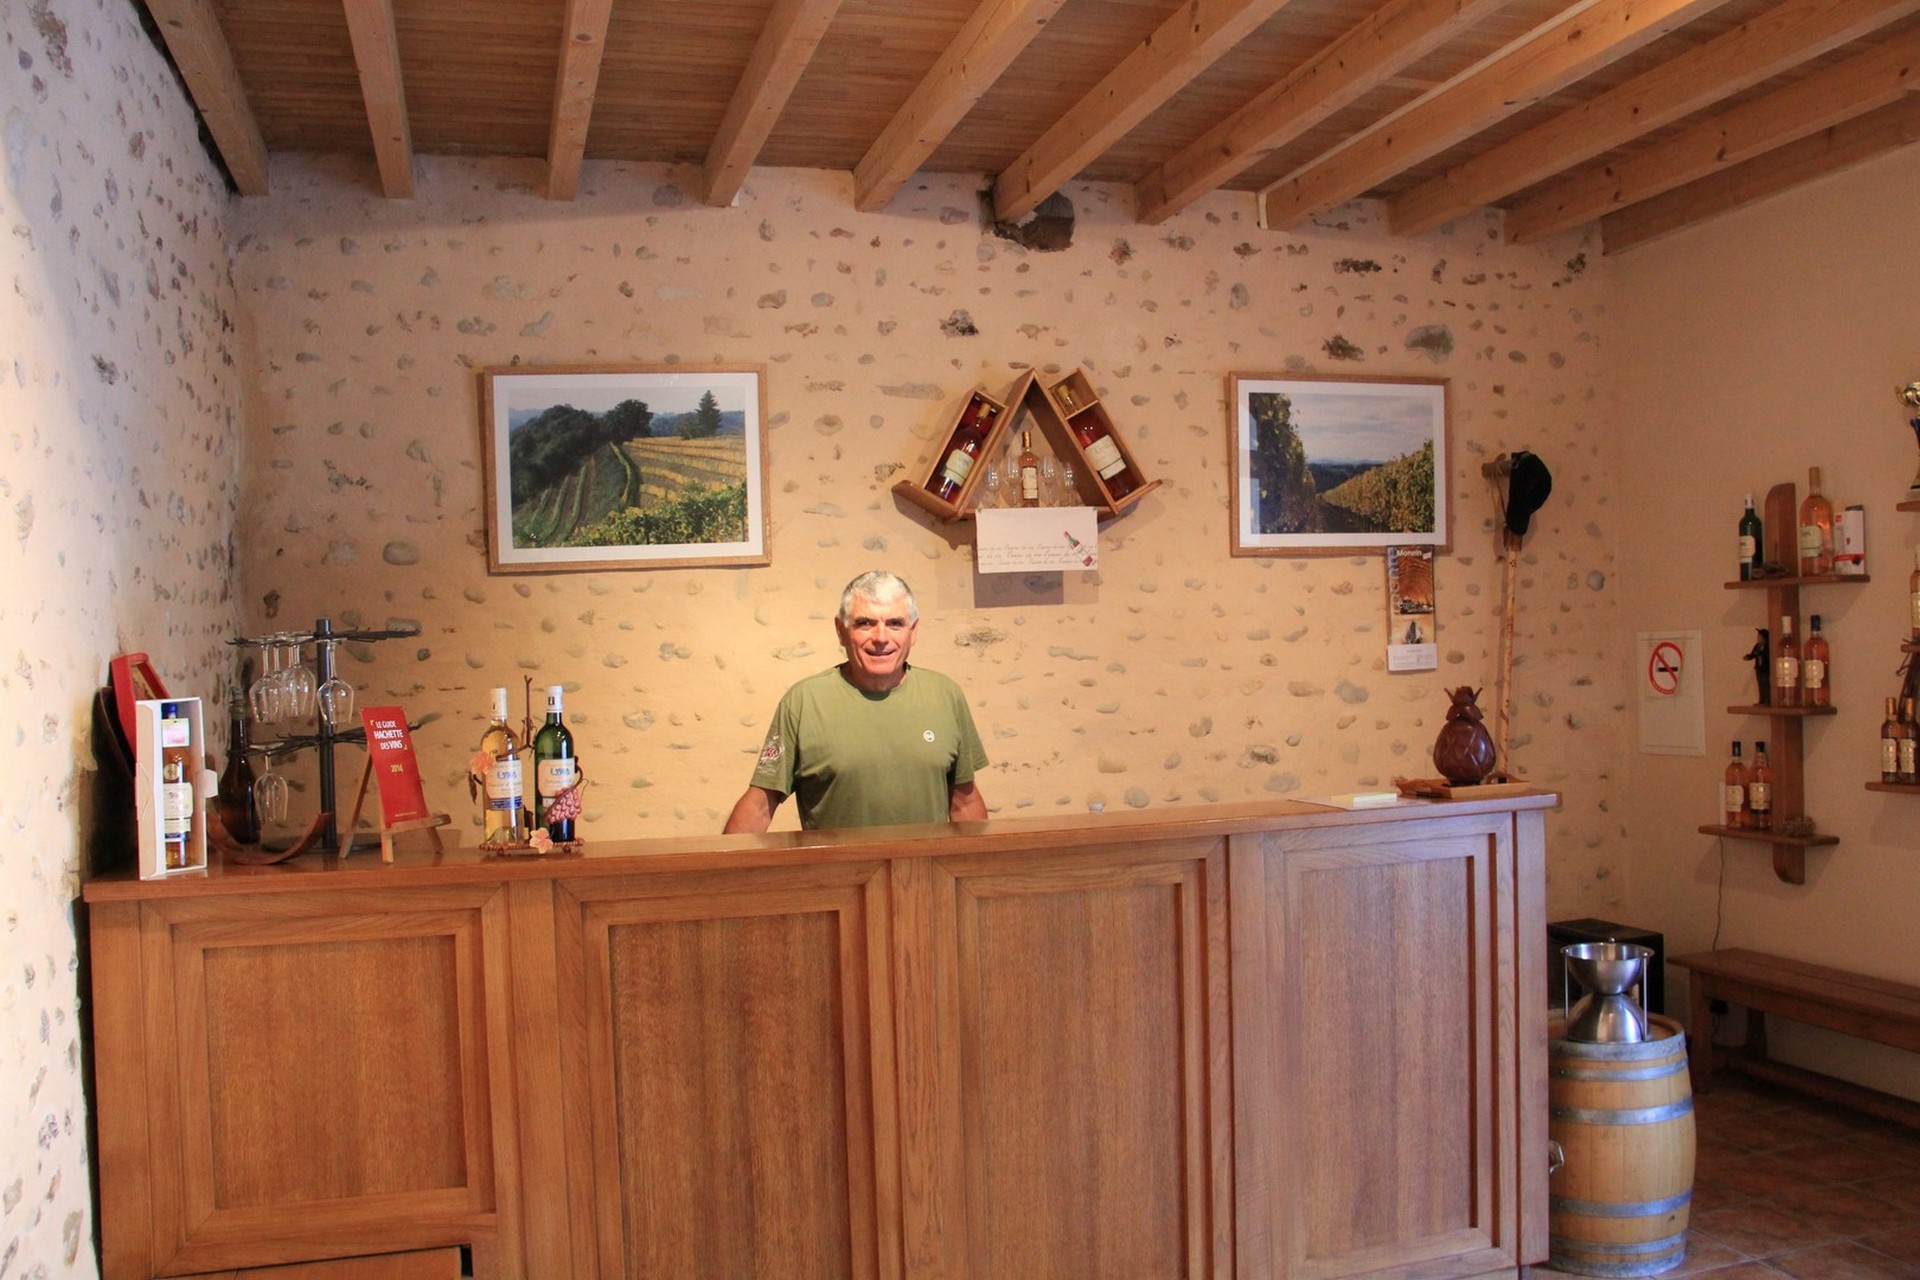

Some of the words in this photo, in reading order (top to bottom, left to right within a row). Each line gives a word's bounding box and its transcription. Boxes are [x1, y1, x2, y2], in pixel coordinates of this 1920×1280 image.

[375, 721, 382, 729] LE
[382, 720, 397, 728] GUIDE
[373, 729, 404, 740] HACHETTE
[380, 742, 390, 750] DES
[390, 740, 403, 749] VINS
